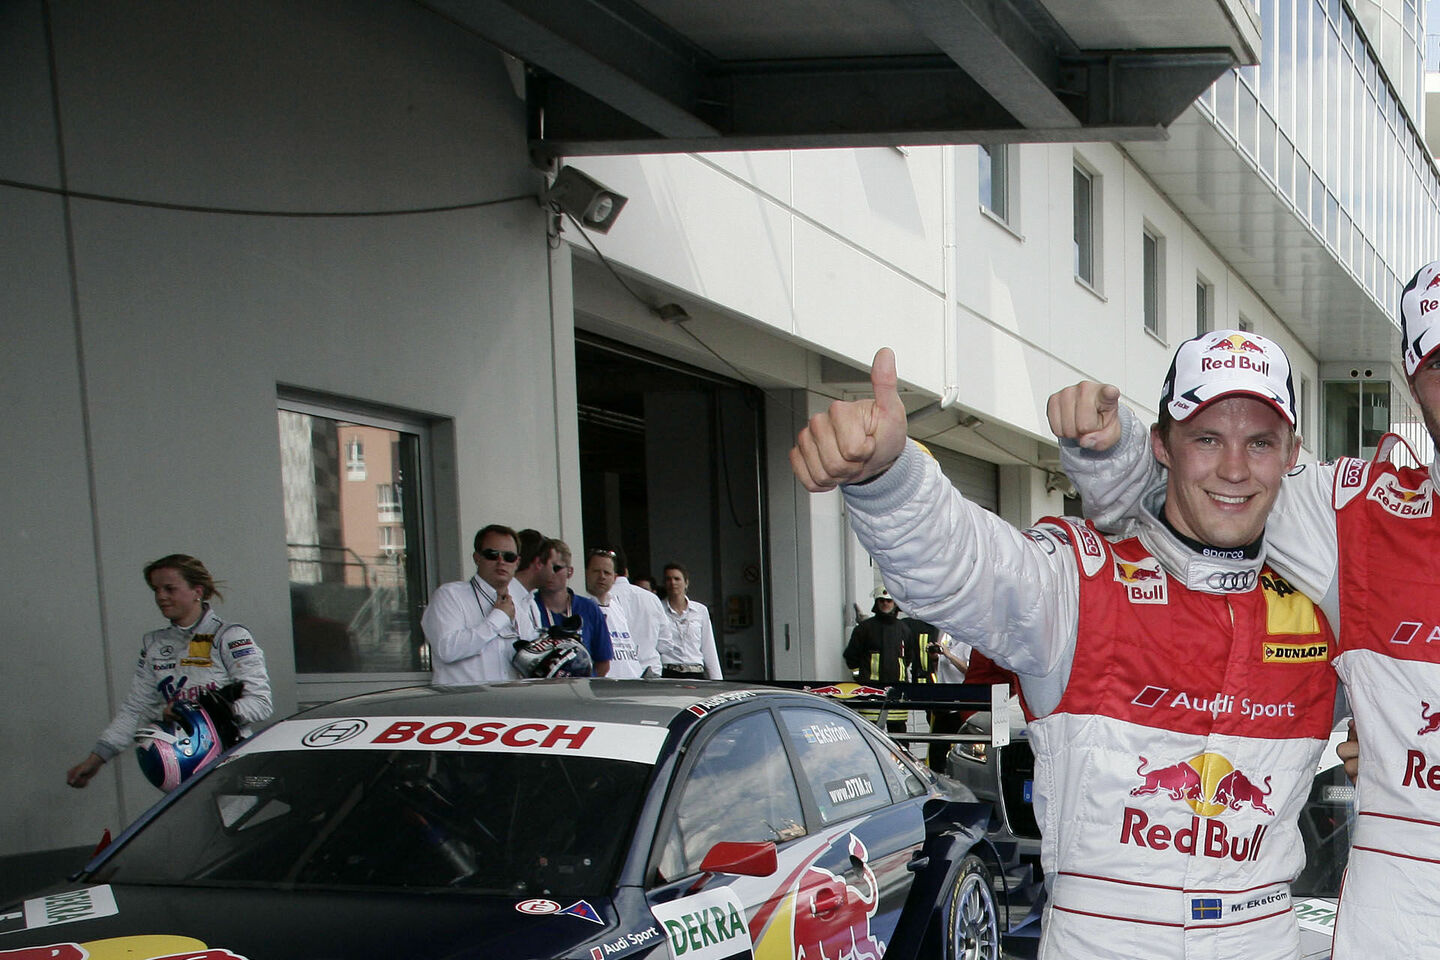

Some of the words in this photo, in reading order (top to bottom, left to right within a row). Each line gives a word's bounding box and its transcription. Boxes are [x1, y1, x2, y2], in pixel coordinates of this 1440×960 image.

[1201, 355, 1235, 372] Red
[1239, 356, 1270, 377] Bull
[1372, 486, 1401, 512] Red
[1400, 501, 1430, 516] Bull
[1203, 548, 1244, 560] sparco
[1131, 585, 1164, 600] Bull
[1275, 646, 1327, 658] DUNLOP
[1170, 692, 1235, 717] Audi
[1241, 698, 1296, 720] Sport
[371, 720, 596, 750] BOSCH
[811, 722, 851, 745] Ekström
[828, 776, 874, 804] www.DTM.tv
[1119, 807, 1197, 857] Red
[1204, 819, 1268, 862] Bull
[45, 889, 96, 925] DEKRA
[1231, 903, 1244, 913] M.
[602, 936, 629, 956] Audi
[627, 926, 659, 949] Sport
[663, 901, 747, 957] DEKRA
